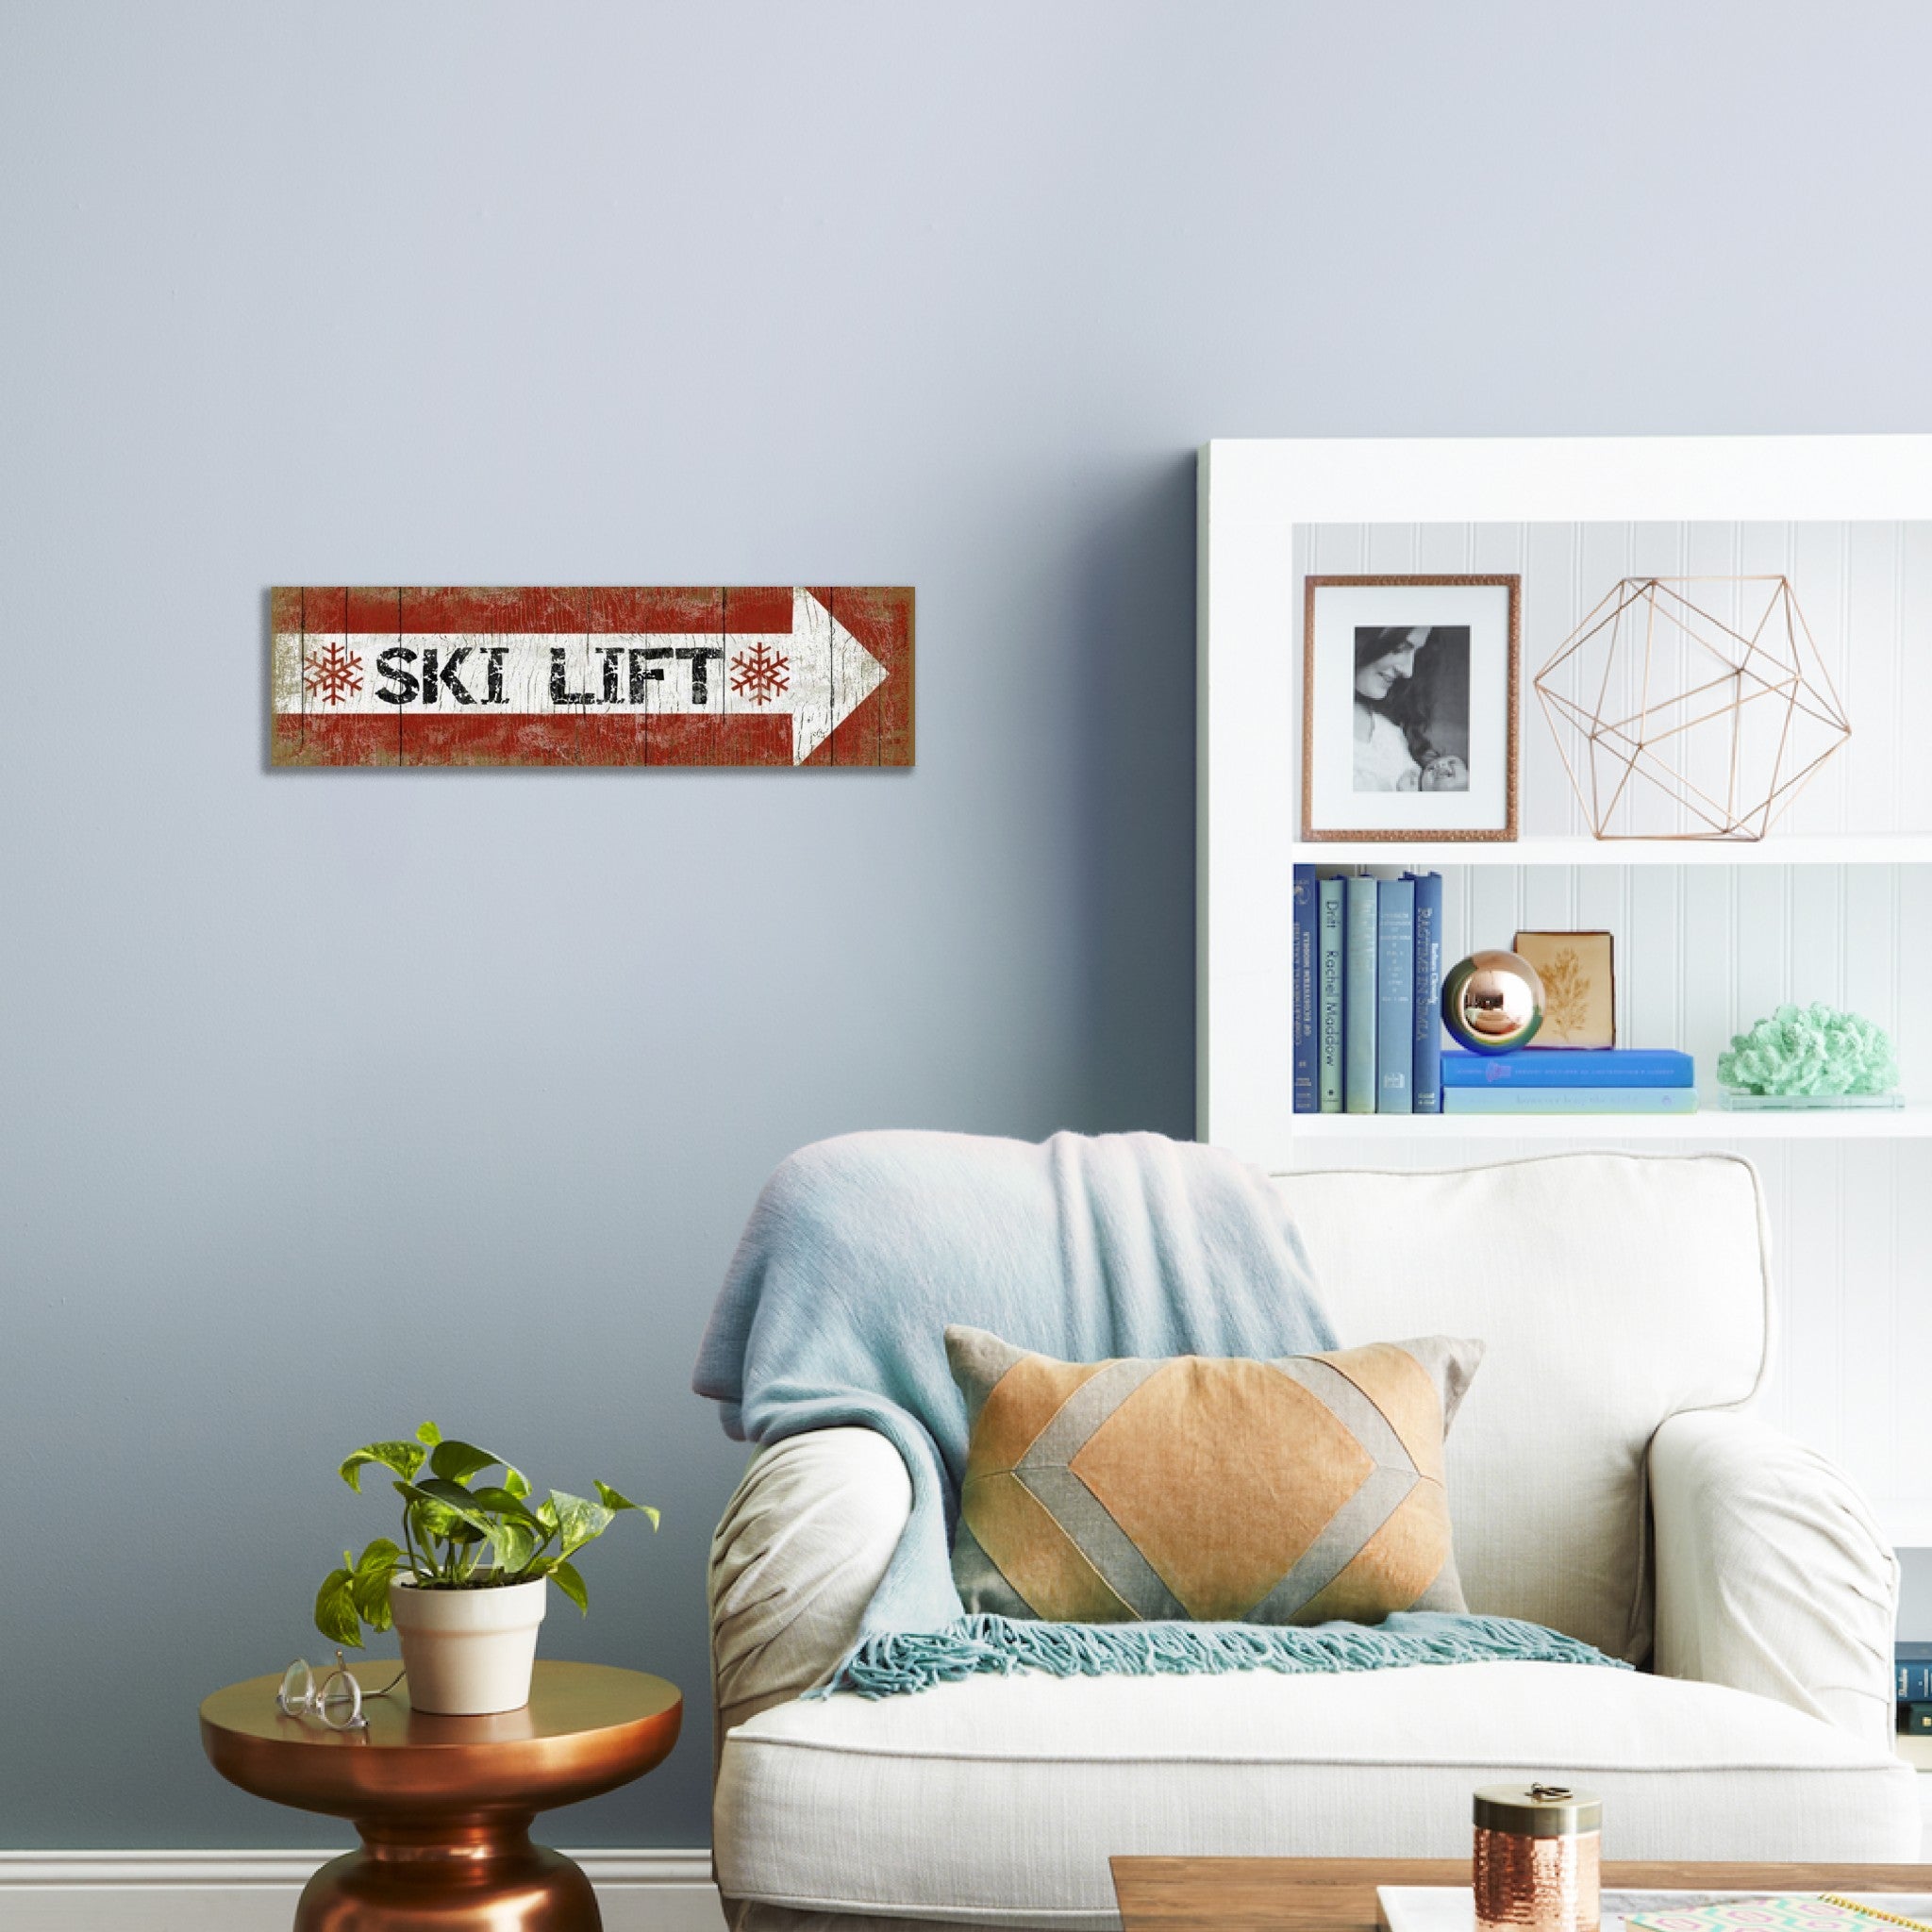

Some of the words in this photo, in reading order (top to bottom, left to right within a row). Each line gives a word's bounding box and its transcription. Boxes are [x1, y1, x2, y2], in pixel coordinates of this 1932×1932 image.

[375, 647, 509, 705] SKI
[550, 647, 724, 705] LIFT
[1325, 900, 1340, 927] Drift
[1325, 951, 1340, 997] Rachel
[1325, 1003, 1340, 1066] Maddow
